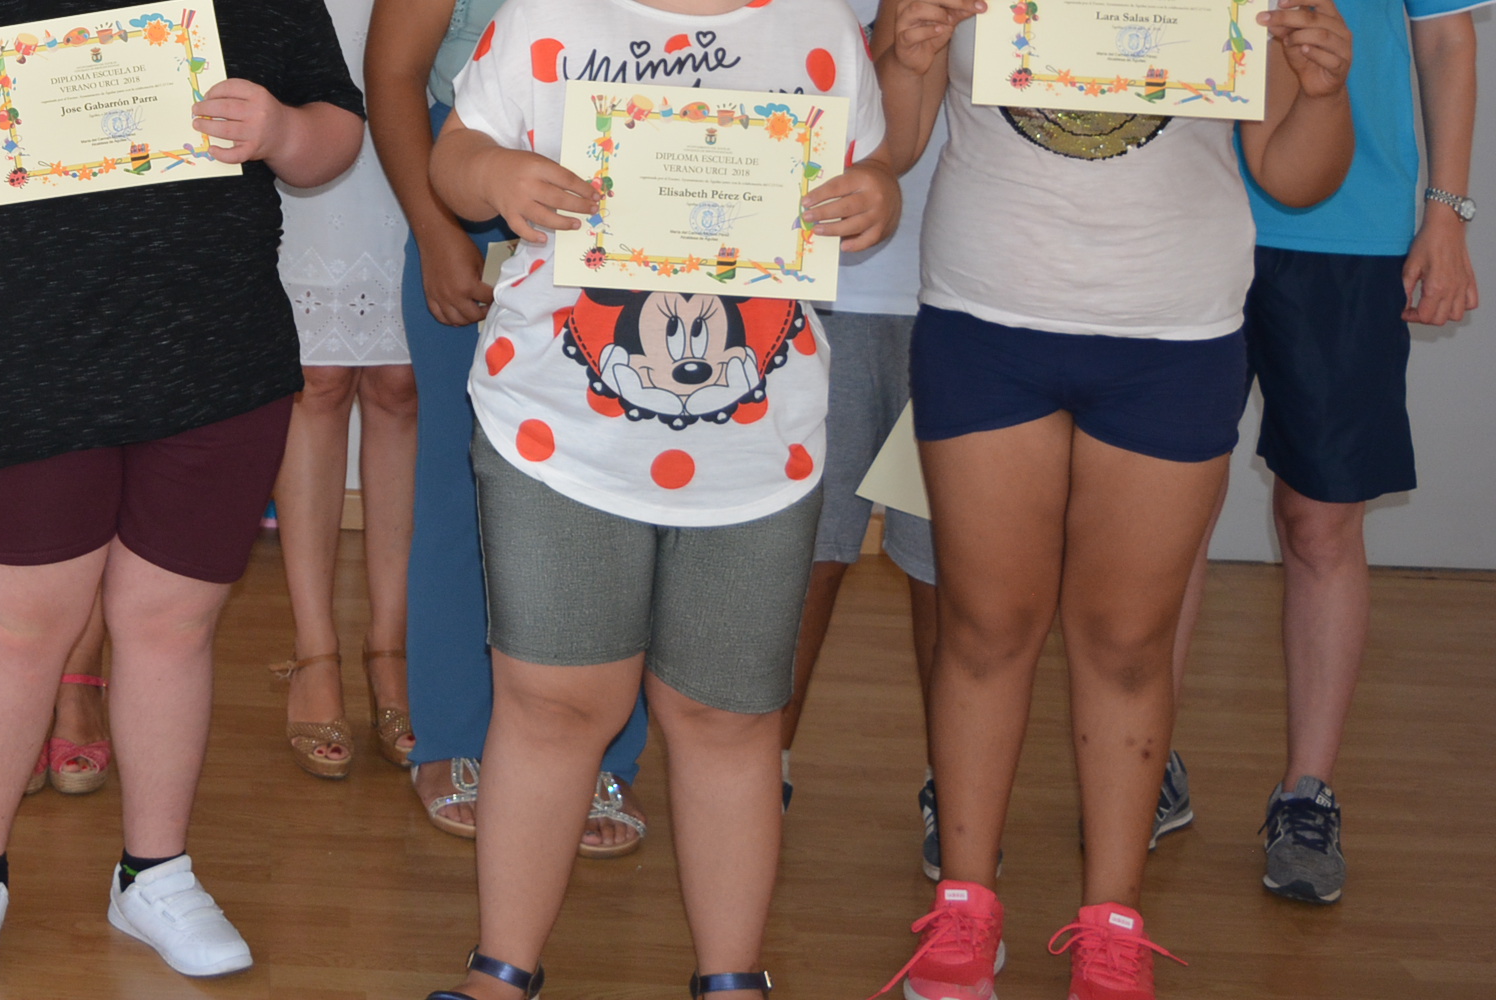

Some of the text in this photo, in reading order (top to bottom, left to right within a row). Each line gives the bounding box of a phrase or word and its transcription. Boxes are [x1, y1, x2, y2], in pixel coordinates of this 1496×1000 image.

[1096, 11, 1120, 21] Lara
[1122, 12, 1150, 23] Salas
[50, 73, 91, 85] DIPLOMA
[92, 67, 131, 79] ESCUELA
[132, 64, 146, 72] DE
[59, 82, 97, 93] VERANO
[99, 79, 119, 88] URCI
[123, 76, 141, 85] 2018
[60, 106, 82, 117] Jose
[84, 98, 130, 111] Gabarrón
[131, 95, 158, 105] Parra
[655, 152, 759, 166] DIPLOMA ESCUELA DE
[663, 164, 750, 177] VERANO URCI 2018
[658, 186, 763, 202] Elisabeth Pérez Gea
